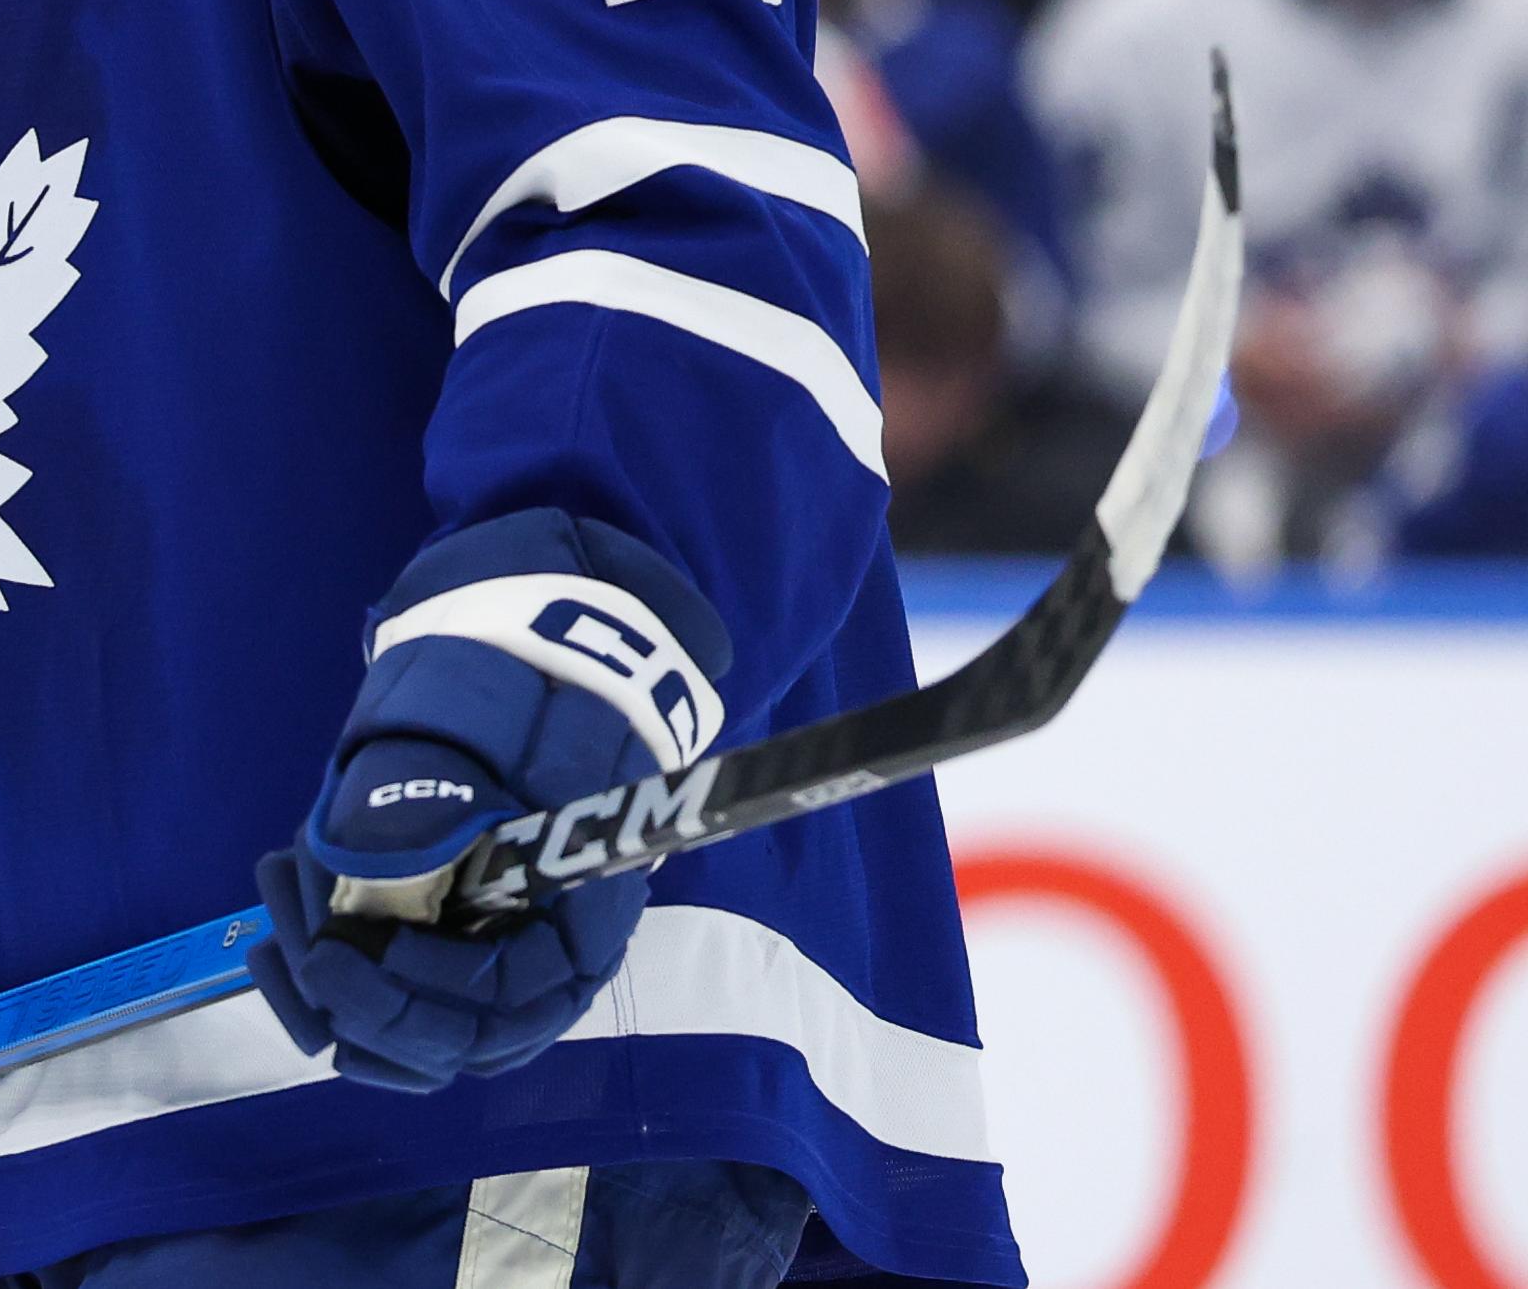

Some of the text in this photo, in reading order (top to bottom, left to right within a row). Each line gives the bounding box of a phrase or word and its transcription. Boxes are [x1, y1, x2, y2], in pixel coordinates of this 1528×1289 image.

[528, 597, 699, 768] CC
[368, 778, 475, 808] CCM
[460, 756, 722, 897] CCM
